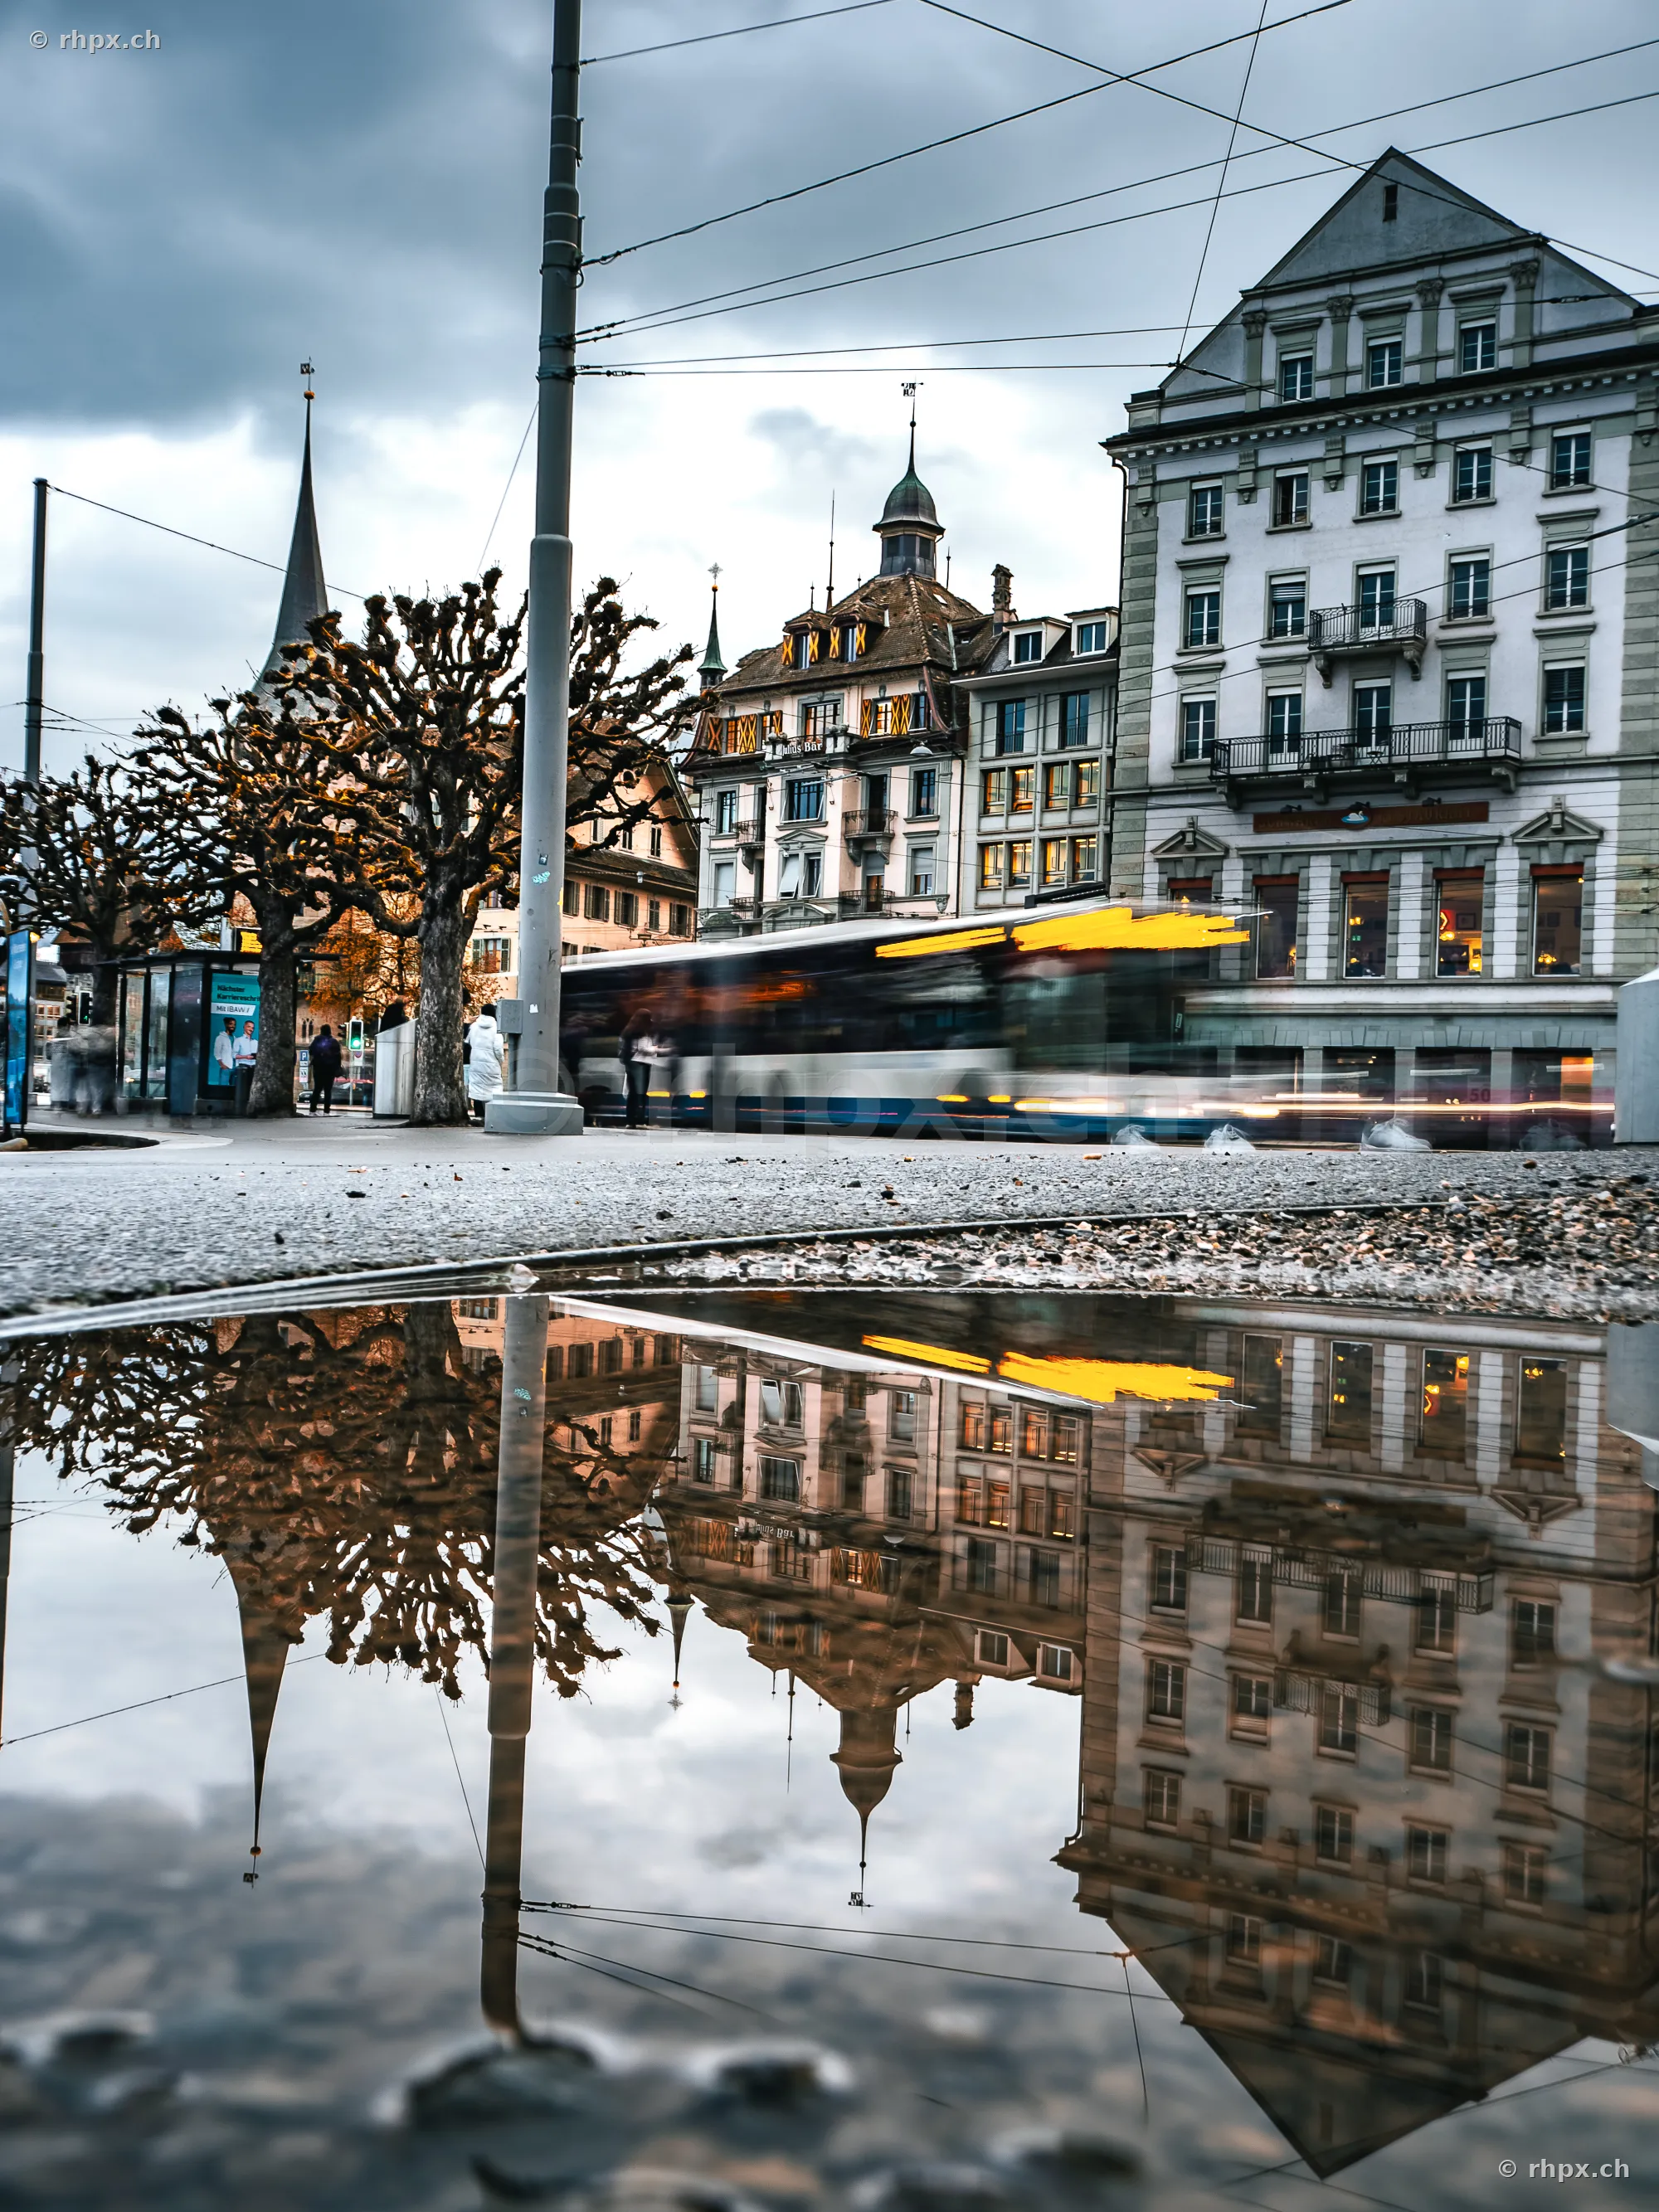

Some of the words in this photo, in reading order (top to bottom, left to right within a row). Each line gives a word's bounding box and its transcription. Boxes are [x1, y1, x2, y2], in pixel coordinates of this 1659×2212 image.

[782, 745, 801, 756] Julius
[804, 741, 822, 752] Bär
[216, 984, 246, 993] Nächster
[301, 1052, 307, 1061] P
